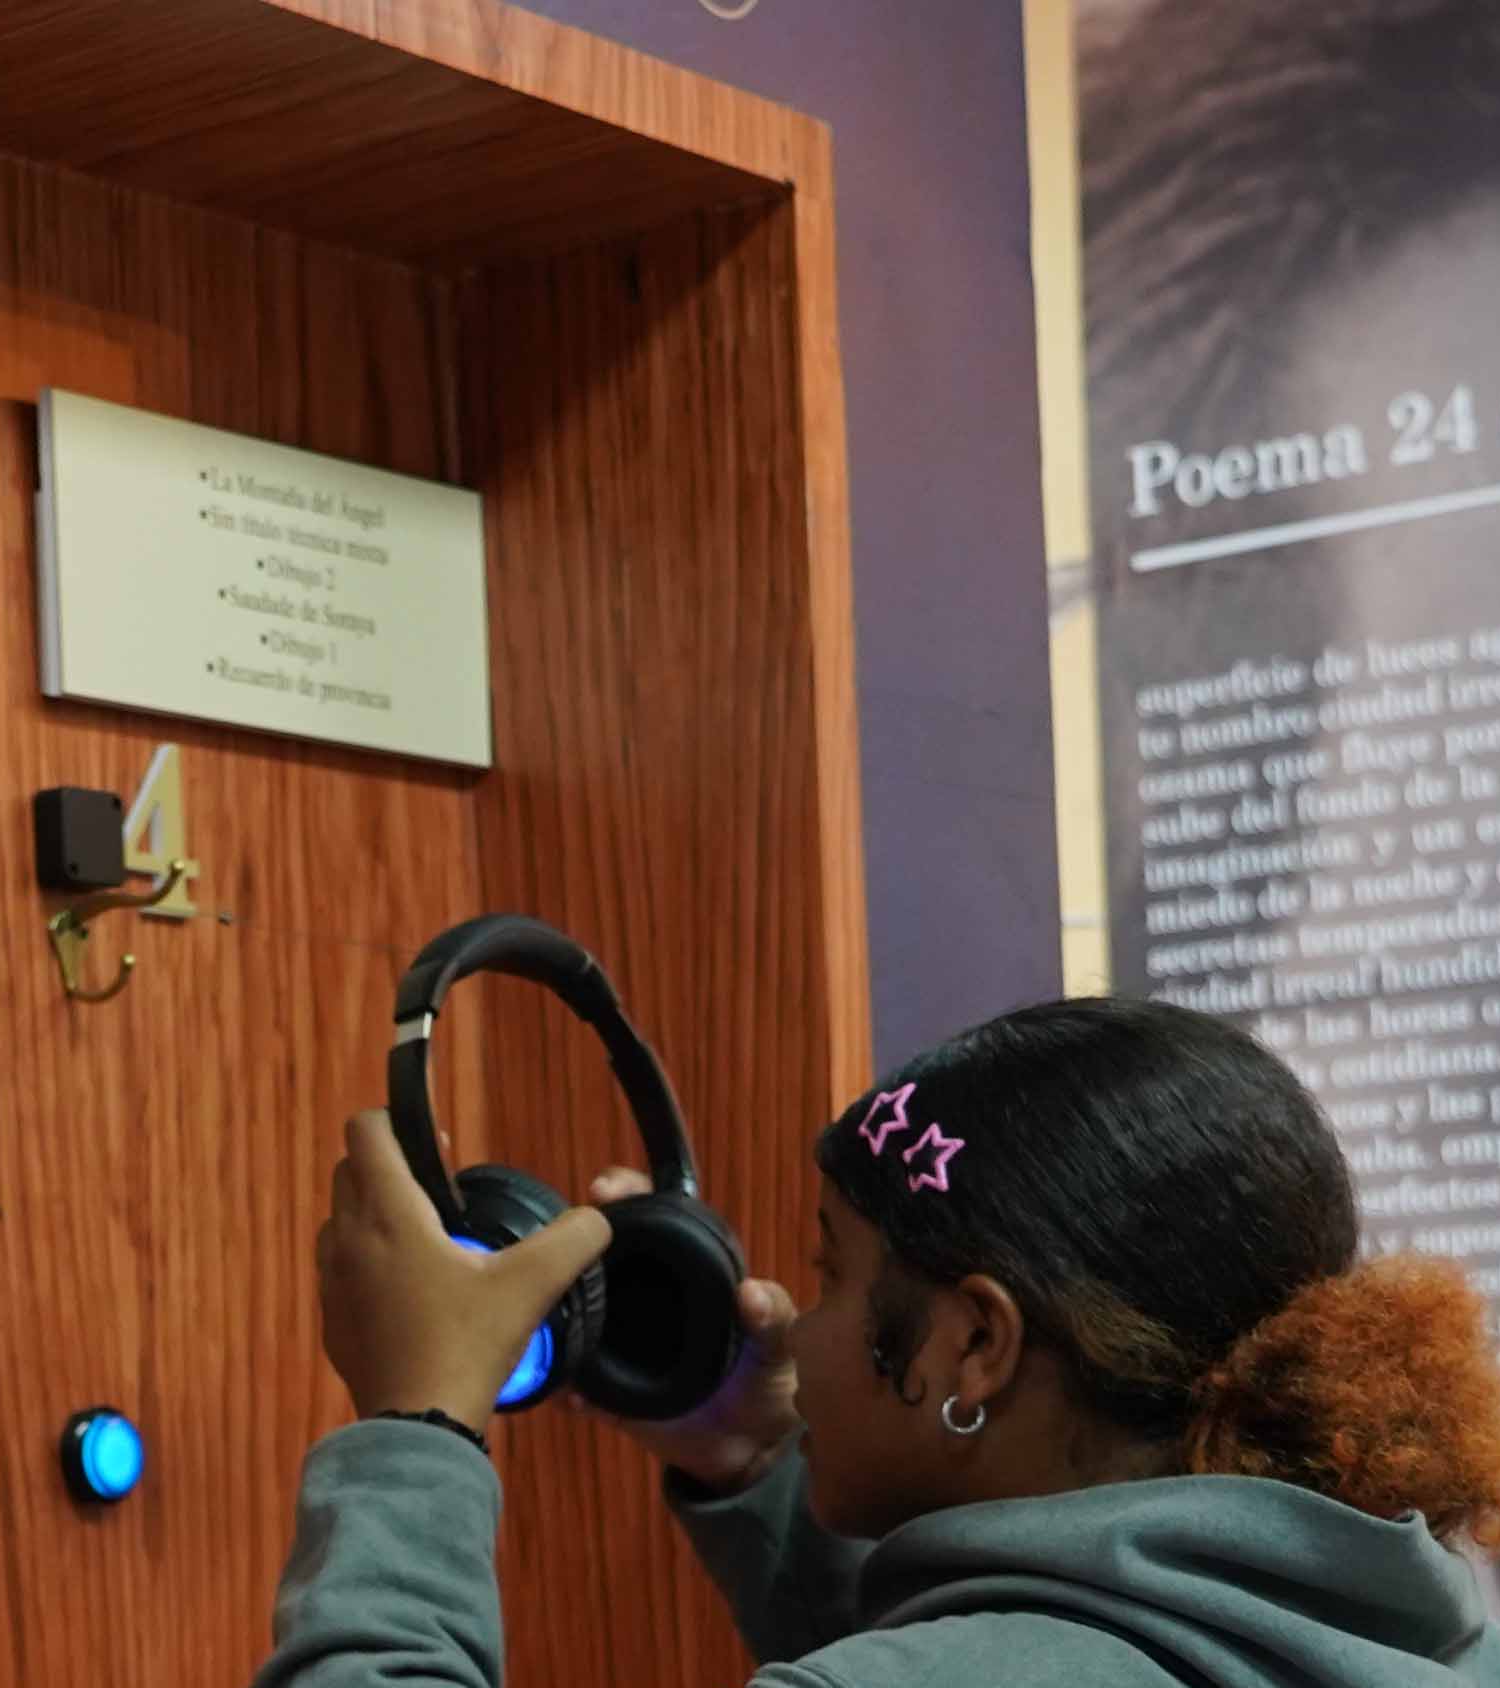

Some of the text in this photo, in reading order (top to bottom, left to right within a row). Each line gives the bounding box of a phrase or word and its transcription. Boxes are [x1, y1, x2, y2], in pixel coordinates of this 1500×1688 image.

[1127, 424, 1369, 519] Poema
[1387, 386, 1482, 467] 24
[121, 741, 200, 917] 4
